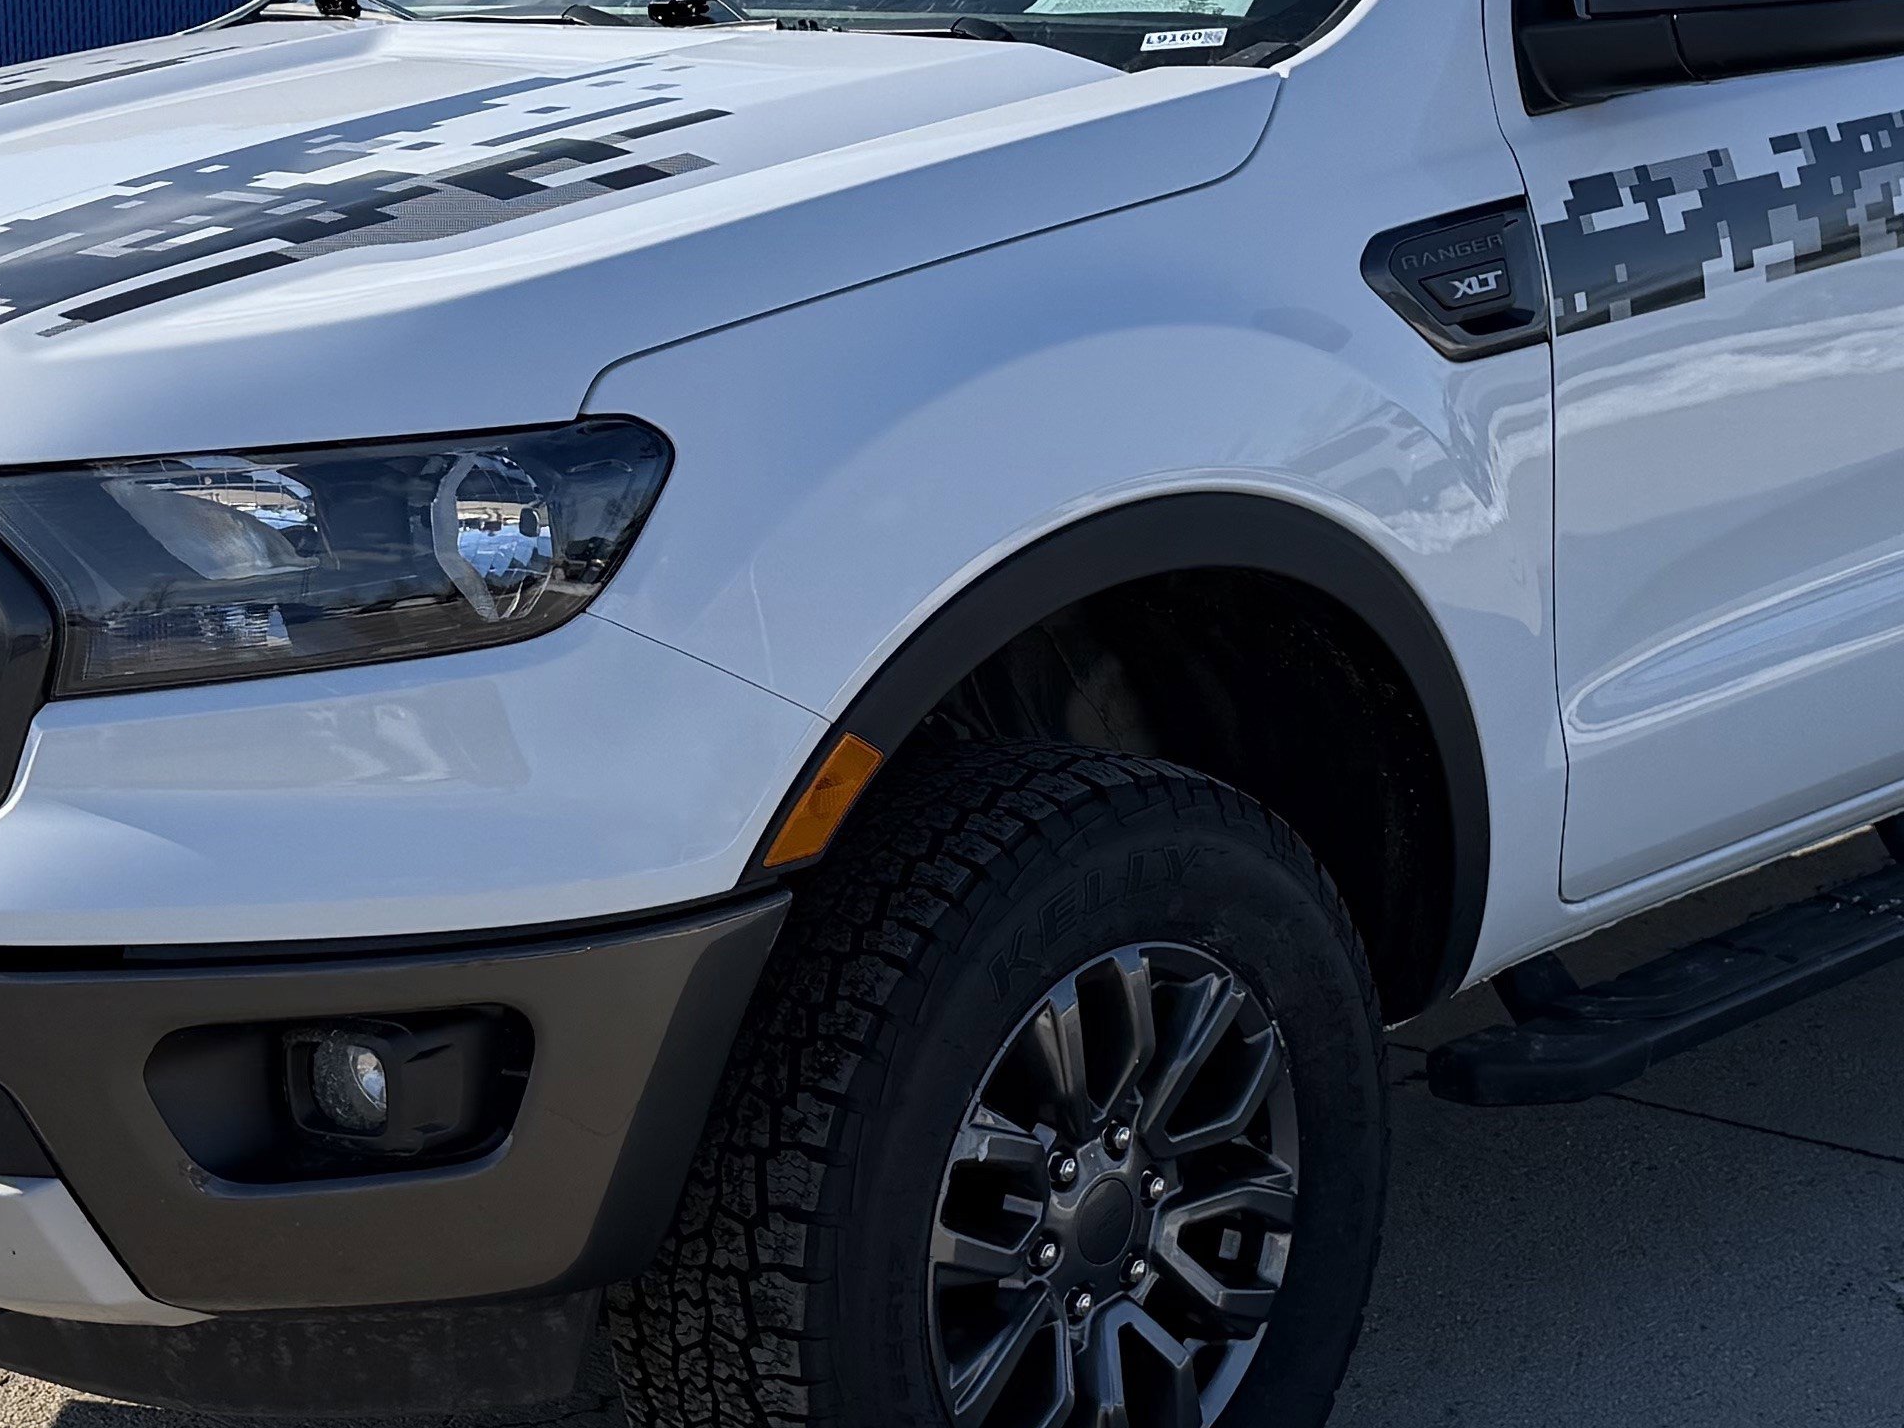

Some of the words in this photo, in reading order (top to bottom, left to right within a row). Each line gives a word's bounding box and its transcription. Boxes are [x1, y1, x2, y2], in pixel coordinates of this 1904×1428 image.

[1401, 233, 1503, 270] RANGER
[1449, 270, 1503, 300] XLT
[988, 845, 1200, 1004] KELLY
